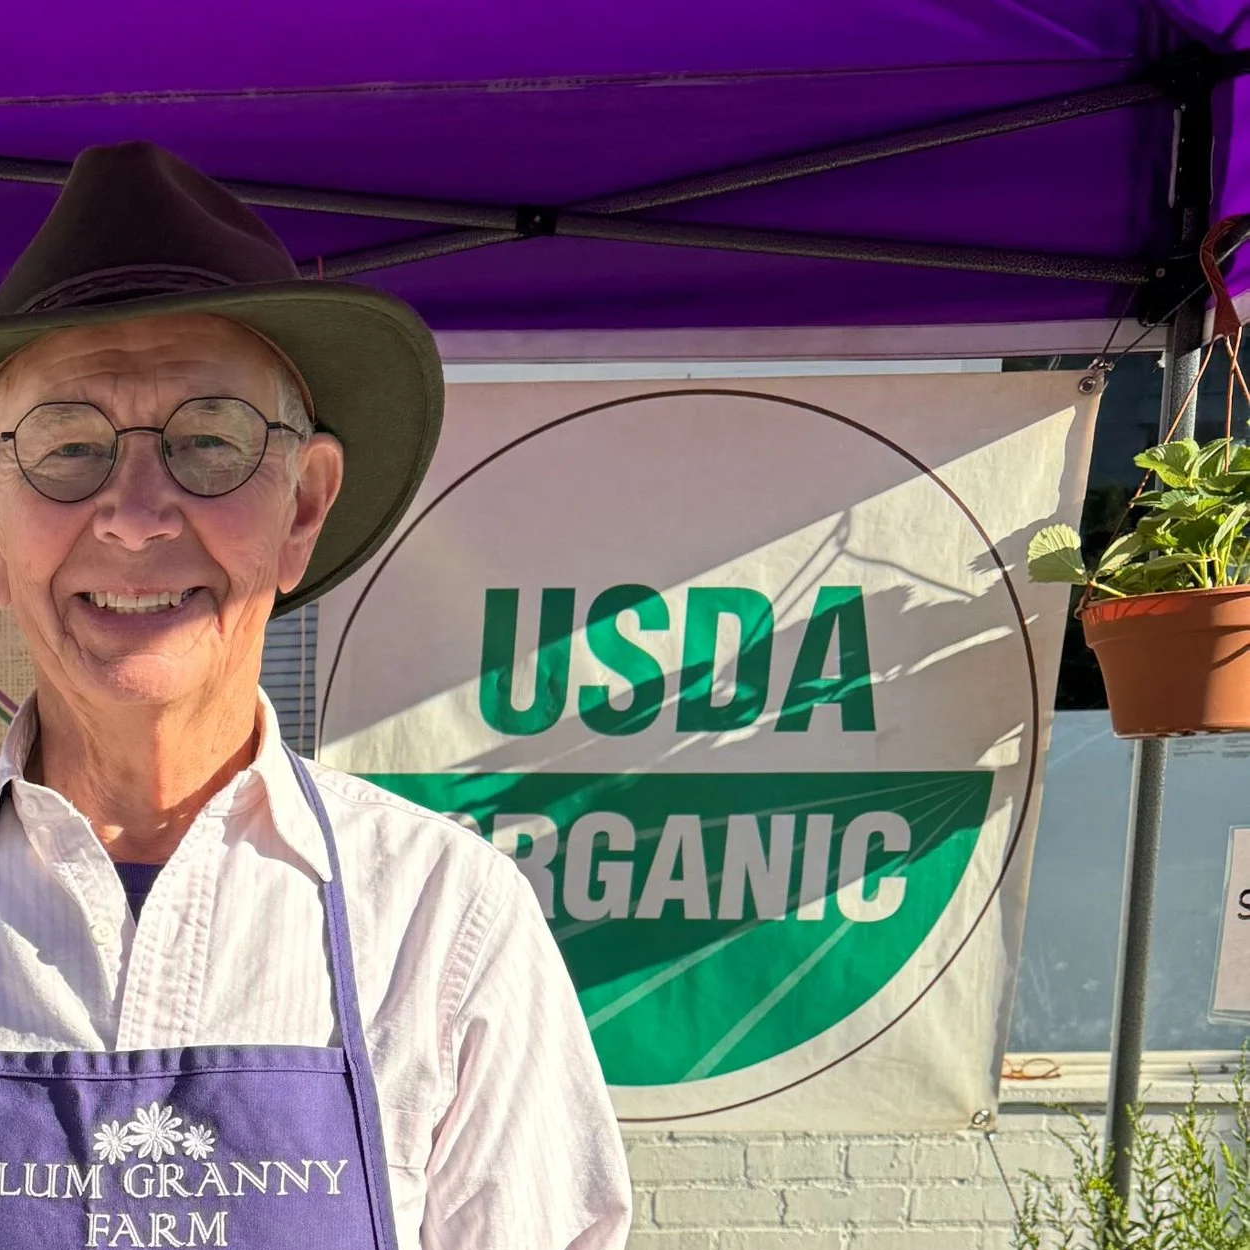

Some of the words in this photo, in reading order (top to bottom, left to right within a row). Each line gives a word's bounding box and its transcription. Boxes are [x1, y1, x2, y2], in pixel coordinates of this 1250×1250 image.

[478, 583, 876, 736] USDA
[440, 811, 912, 923] RGANIC
[123, 1158, 349, 1199] GRANNY
[84, 1211, 229, 1248] FARM
